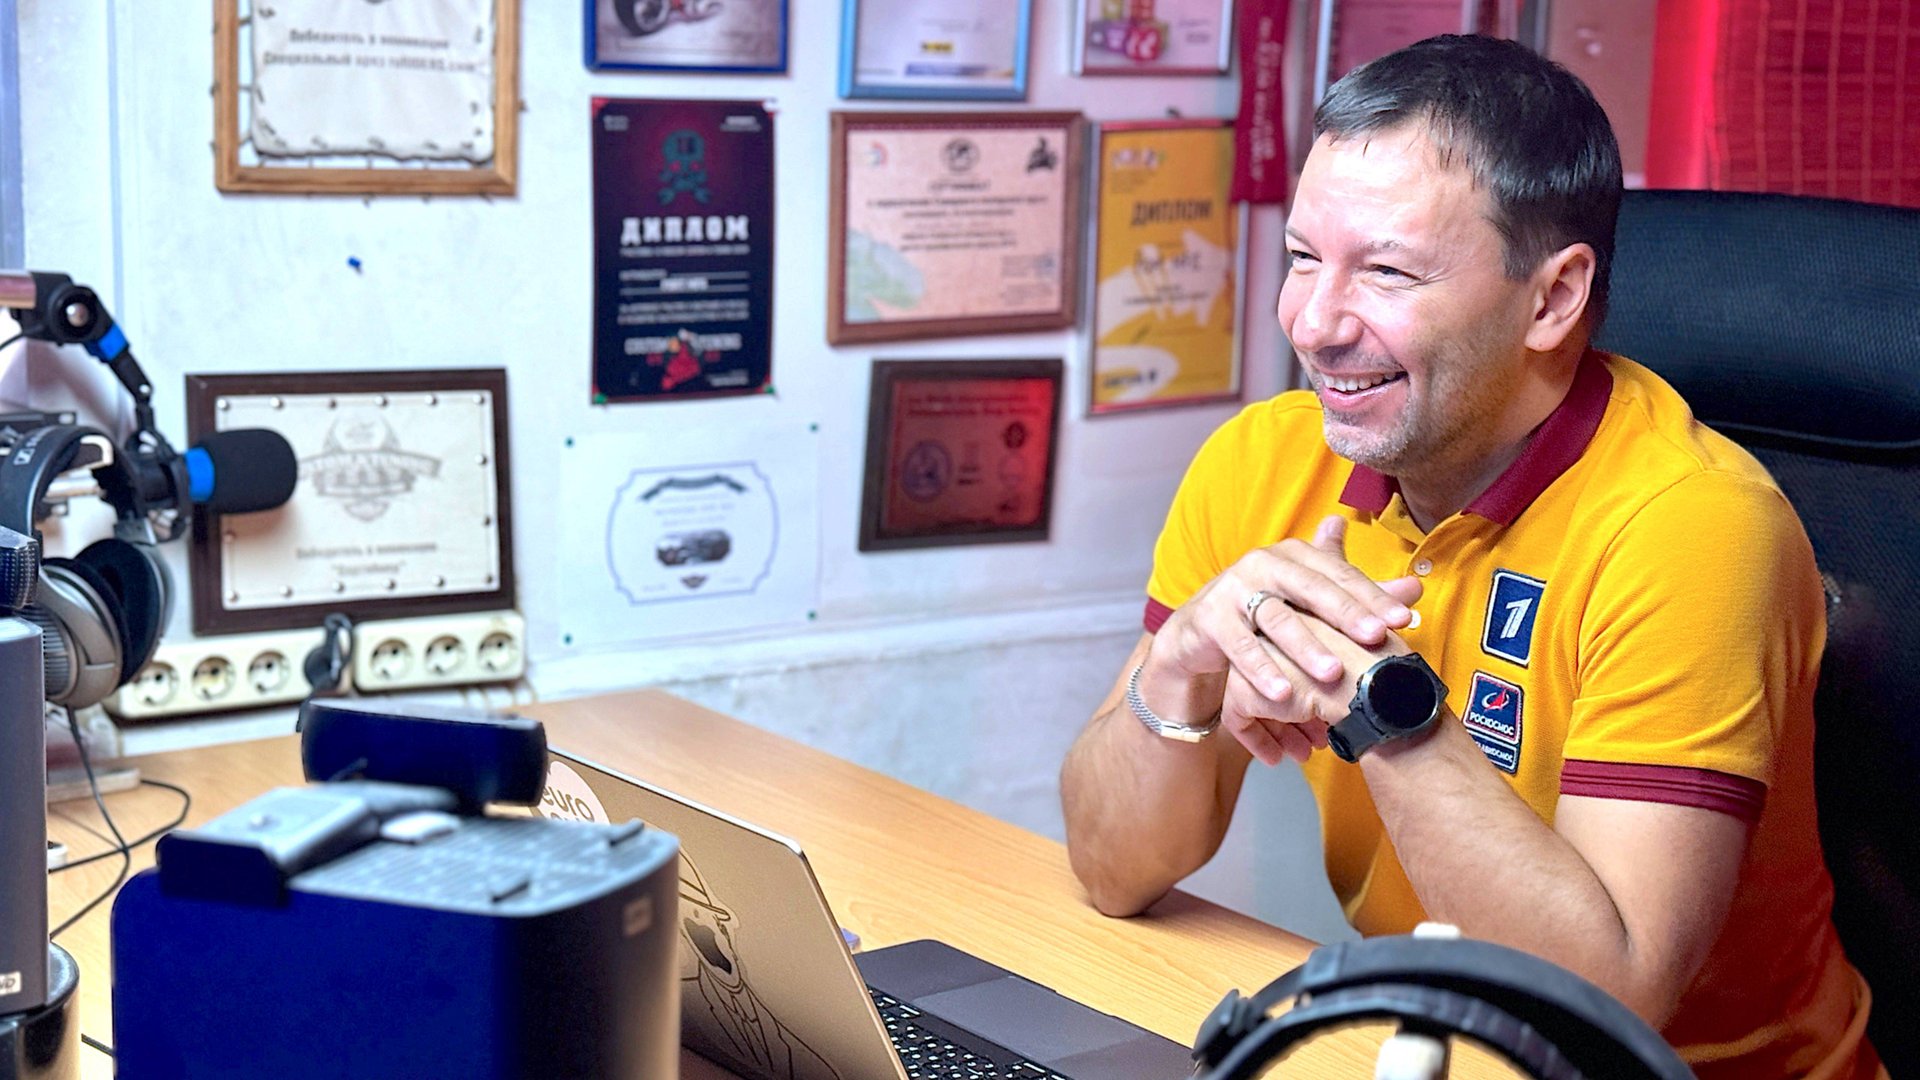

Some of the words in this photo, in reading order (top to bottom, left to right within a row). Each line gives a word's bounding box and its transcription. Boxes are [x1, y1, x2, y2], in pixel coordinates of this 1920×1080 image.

[1131, 200, 1214, 227] ДИПЛОМ
[620, 216, 749, 245] ДИПЛОМ
[1470, 712, 1514, 736] РОСКОСМОС
[1478, 743, 1513, 763] АВКОСМОС
